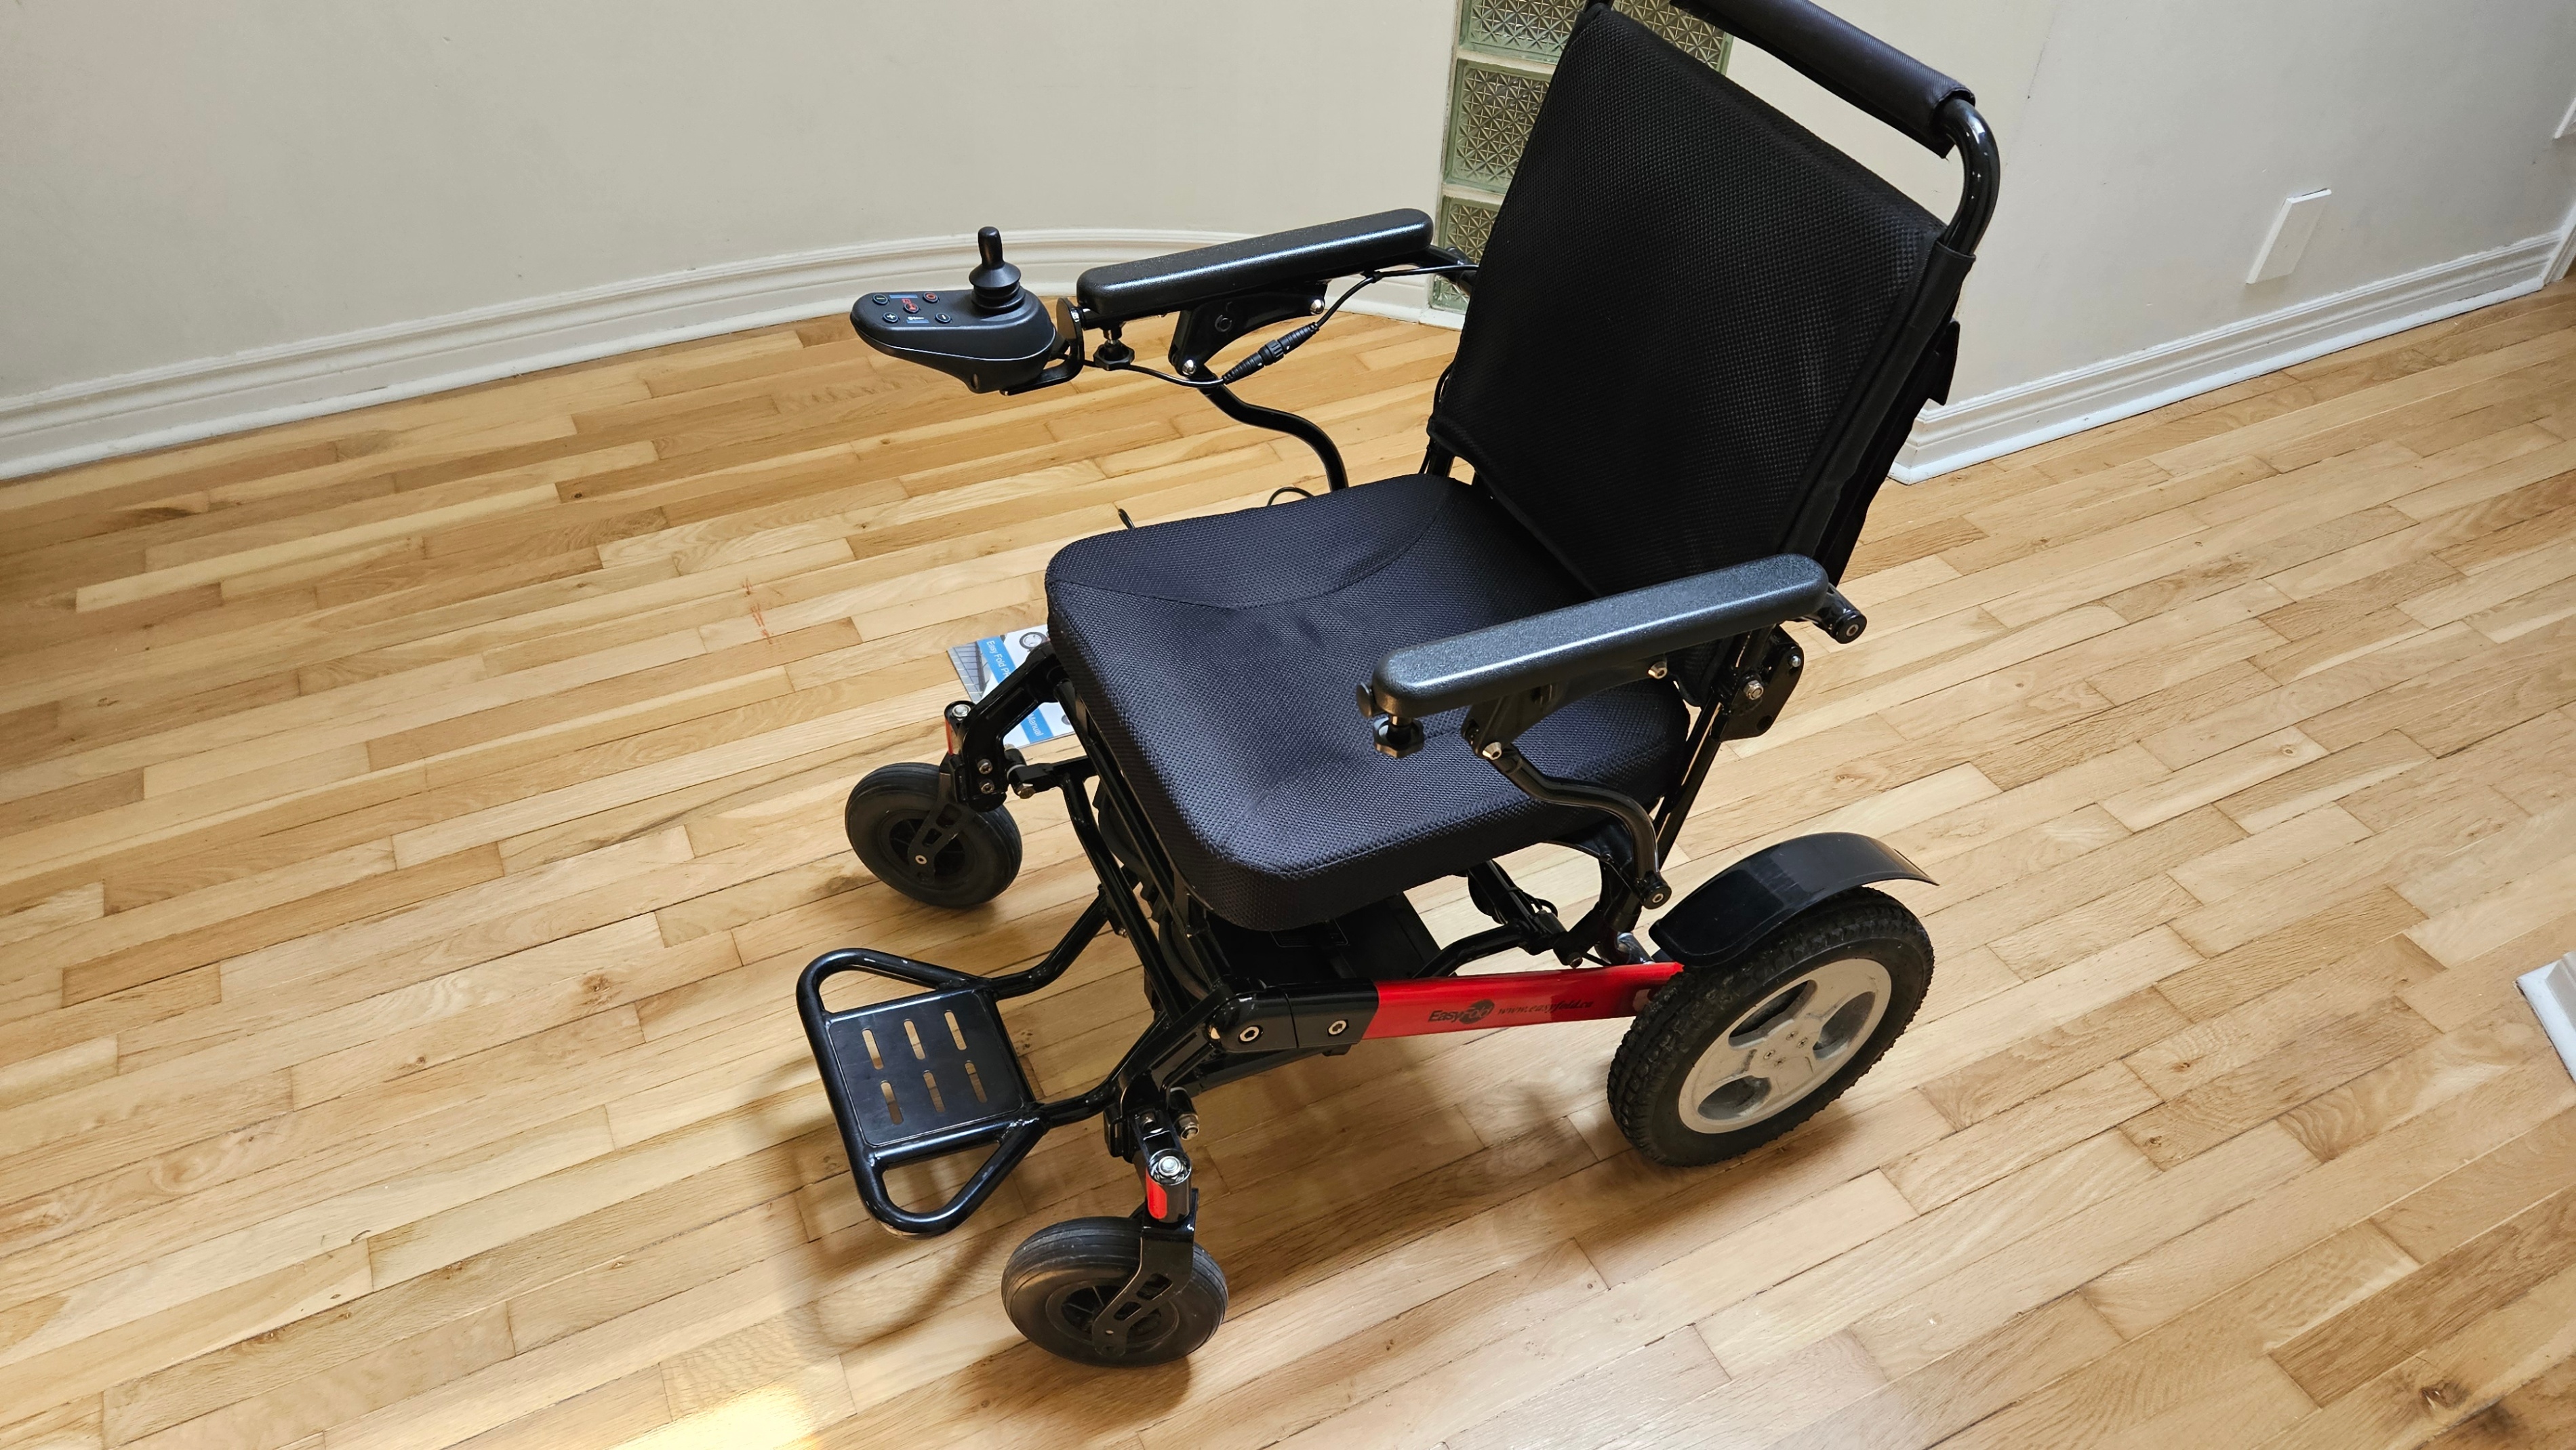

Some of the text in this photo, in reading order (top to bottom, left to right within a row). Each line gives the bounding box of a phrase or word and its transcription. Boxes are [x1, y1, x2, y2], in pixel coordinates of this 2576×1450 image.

[986, 640, 1011, 679] Easy Fold PR
[1027, 712, 1044, 737] Manual
